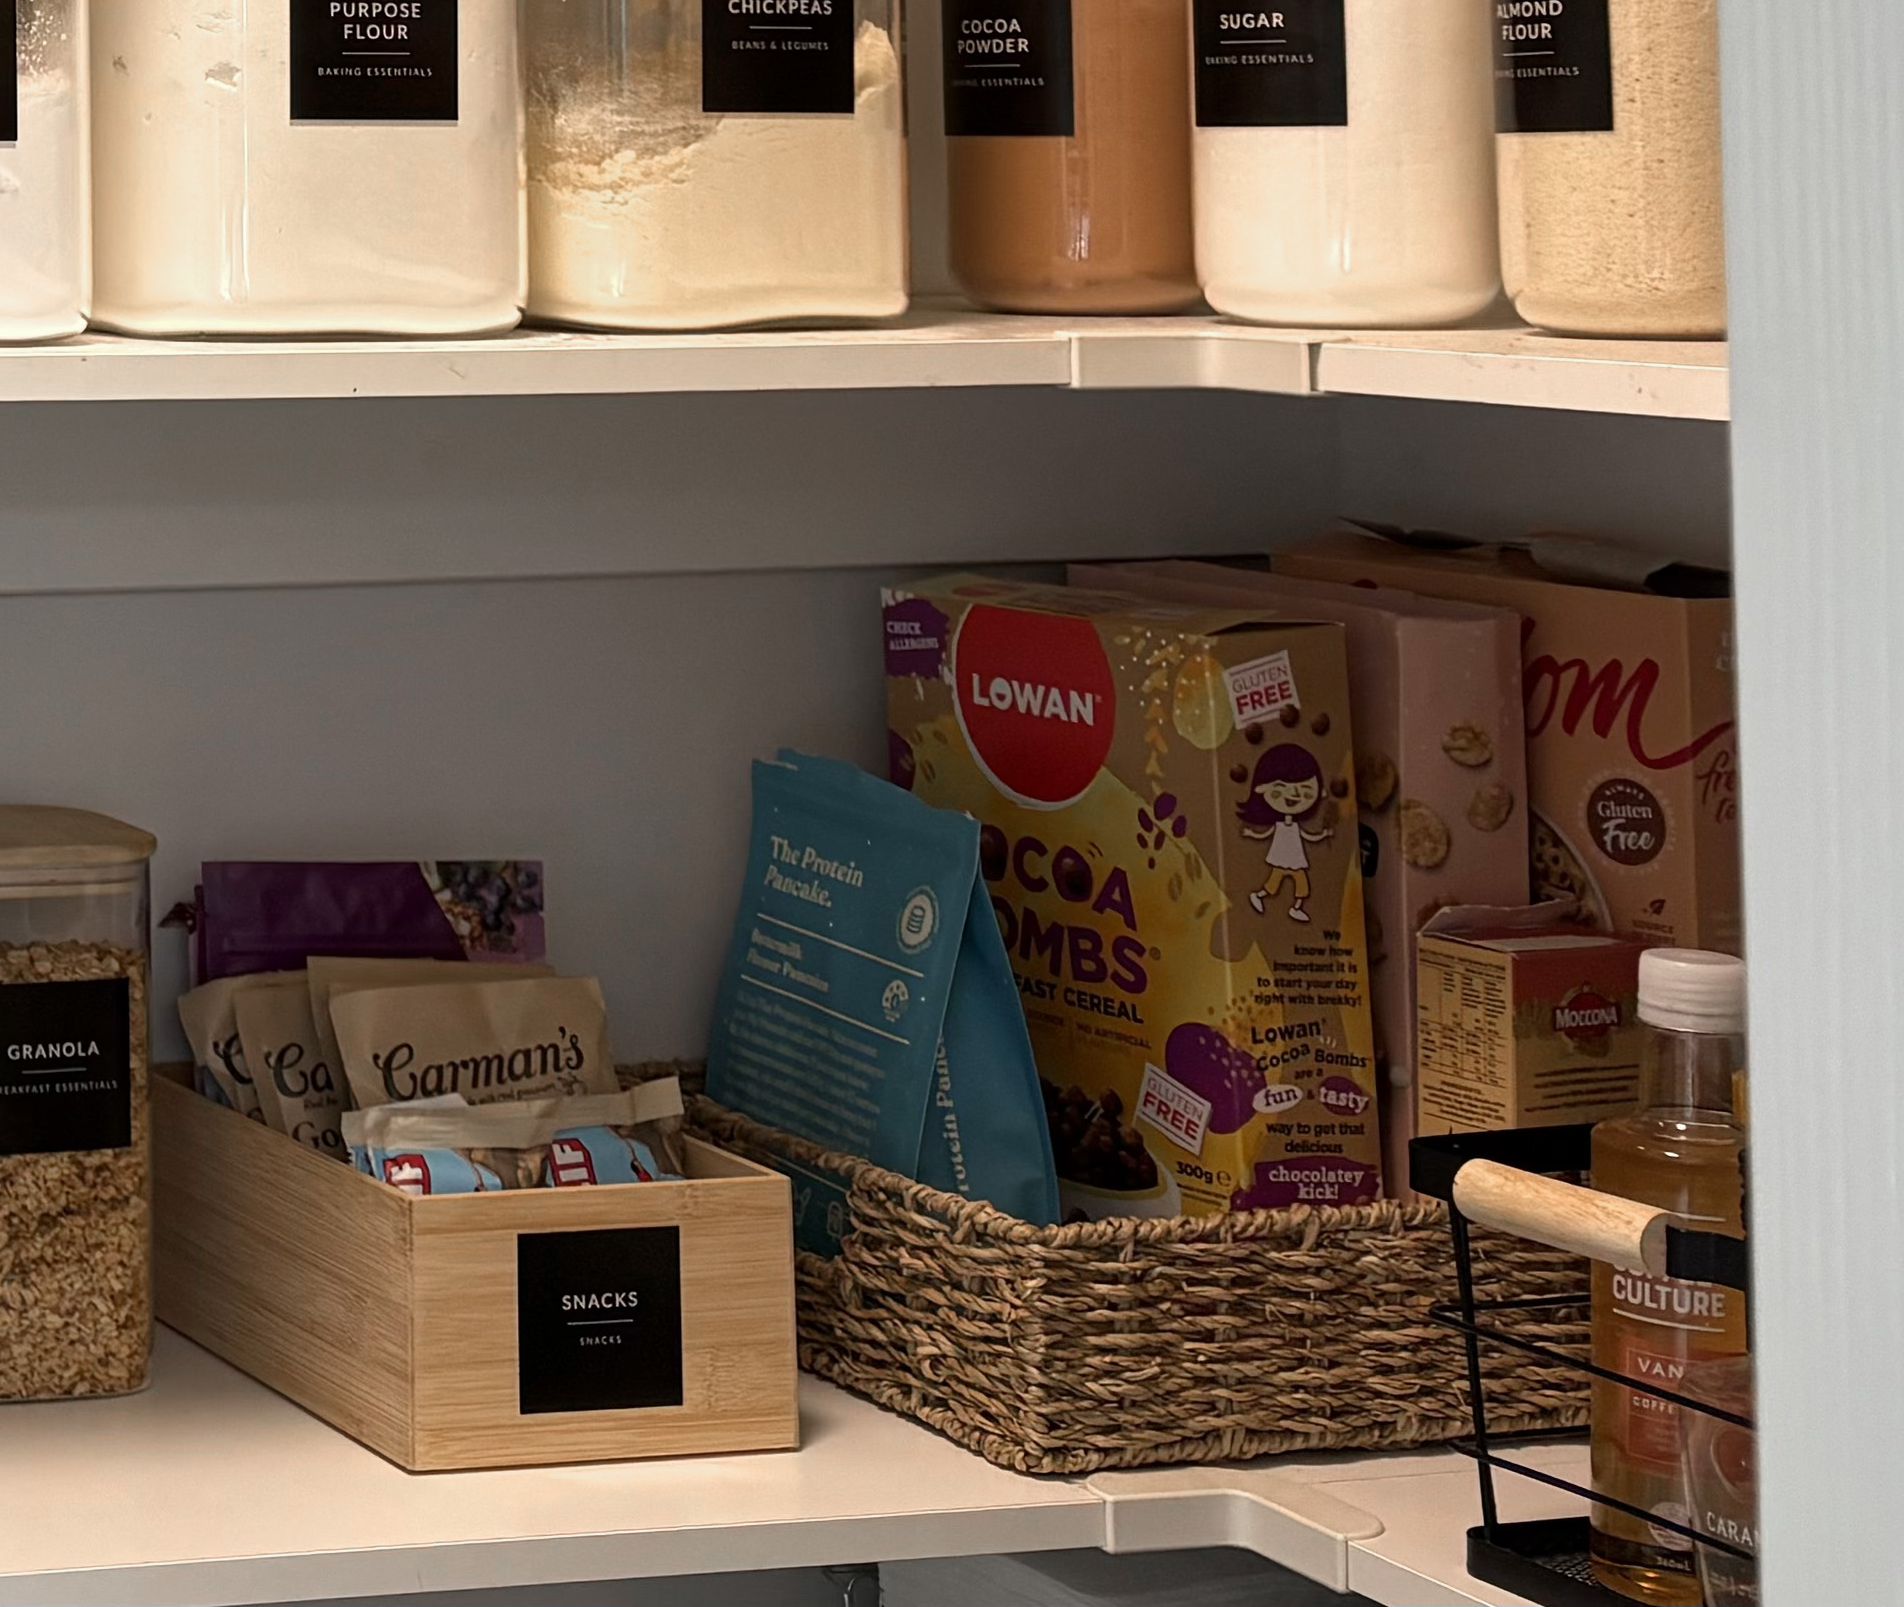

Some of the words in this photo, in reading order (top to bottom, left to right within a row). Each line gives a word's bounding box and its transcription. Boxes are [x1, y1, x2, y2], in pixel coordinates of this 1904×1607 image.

[329, 2, 421, 21] PURPOSE
[1497, 0, 1563, 19] ALMOND
[962, 18, 1021, 34] COCOA
[1219, 12, 1285, 30] SUGAR
[342, 22, 409, 41] FLOUR
[1502, 23, 1552, 40] FLOUR
[731, 40, 766, 52] BEANS
[770, 40, 779, 52] &
[782, 40, 829, 52] LEGUMES
[957, 38, 1029, 54] POWDER
[1241, 53, 1314, 65] ESSENTIALS
[317, 66, 362, 78] BAKING
[366, 66, 433, 78] ESSENTIALS
[1517, 66, 1580, 78] ESSENTIALS
[981, 77, 1045, 87] ESSENTIALS
[1233, 665, 1290, 694] GLUTEN
[972, 673, 1095, 727] LOWAN
[1236, 681, 1294, 715] FREE
[1597, 801, 1653, 820] Gluten
[1601, 819, 1655, 854] Free
[770, 835, 800, 866] The
[800, 846, 864, 887] Protein
[763, 864, 833, 908] Pancake.
[981, 824, 1137, 931] OCOA
[1294, 945, 1325, 956] know
[1329, 945, 1353, 956] how
[1274, 961, 1333, 974] important
[1348, 961, 1357, 973] is
[1257, 977, 1270, 987] to
[1274, 977, 1302, 988] start
[1306, 979, 1332, 991] your
[1335, 979, 1357, 992] day
[1063, 986, 1144, 1024] CEREAL
[1254, 994, 1284, 1006] right
[1288, 995, 1314, 1005] with
[1251, 1020, 1321, 1045] Lowan
[7, 1040, 100, 1061] GRANOLA
[1256, 1043, 1311, 1071] Cocoa
[1315, 1048, 1367, 1068] Bombs
[372, 1026, 585, 1101] Carman's
[1295, 1069, 1312, 1080] are
[1315, 1069, 1323, 1077] a
[55, 1079, 118, 1093] ESSENTIALS
[1148, 1077, 1203, 1120] GLUTEN
[1263, 1087, 1299, 1108] fun
[1318, 1086, 1369, 1114] tasty
[1143, 1091, 1200, 1141] FREE
[1266, 1123, 1294, 1135] way
[1297, 1123, 1310, 1134] to
[1314, 1123, 1336, 1137] get
[1339, 1123, 1365, 1134] that
[943, 1113, 970, 1192] rotein
[1284, 1140, 1343, 1153] delicious
[1176, 1161, 1213, 1184] 300g
[1268, 1165, 1365, 1186] chocolatey
[1297, 1184, 1340, 1200] kick!
[562, 1292, 638, 1311] SNACKS
[1613, 1275, 1725, 1318] CULTURE
[580, 1336, 622, 1346] SNACKS
[1706, 1512, 1759, 1547] CARA
